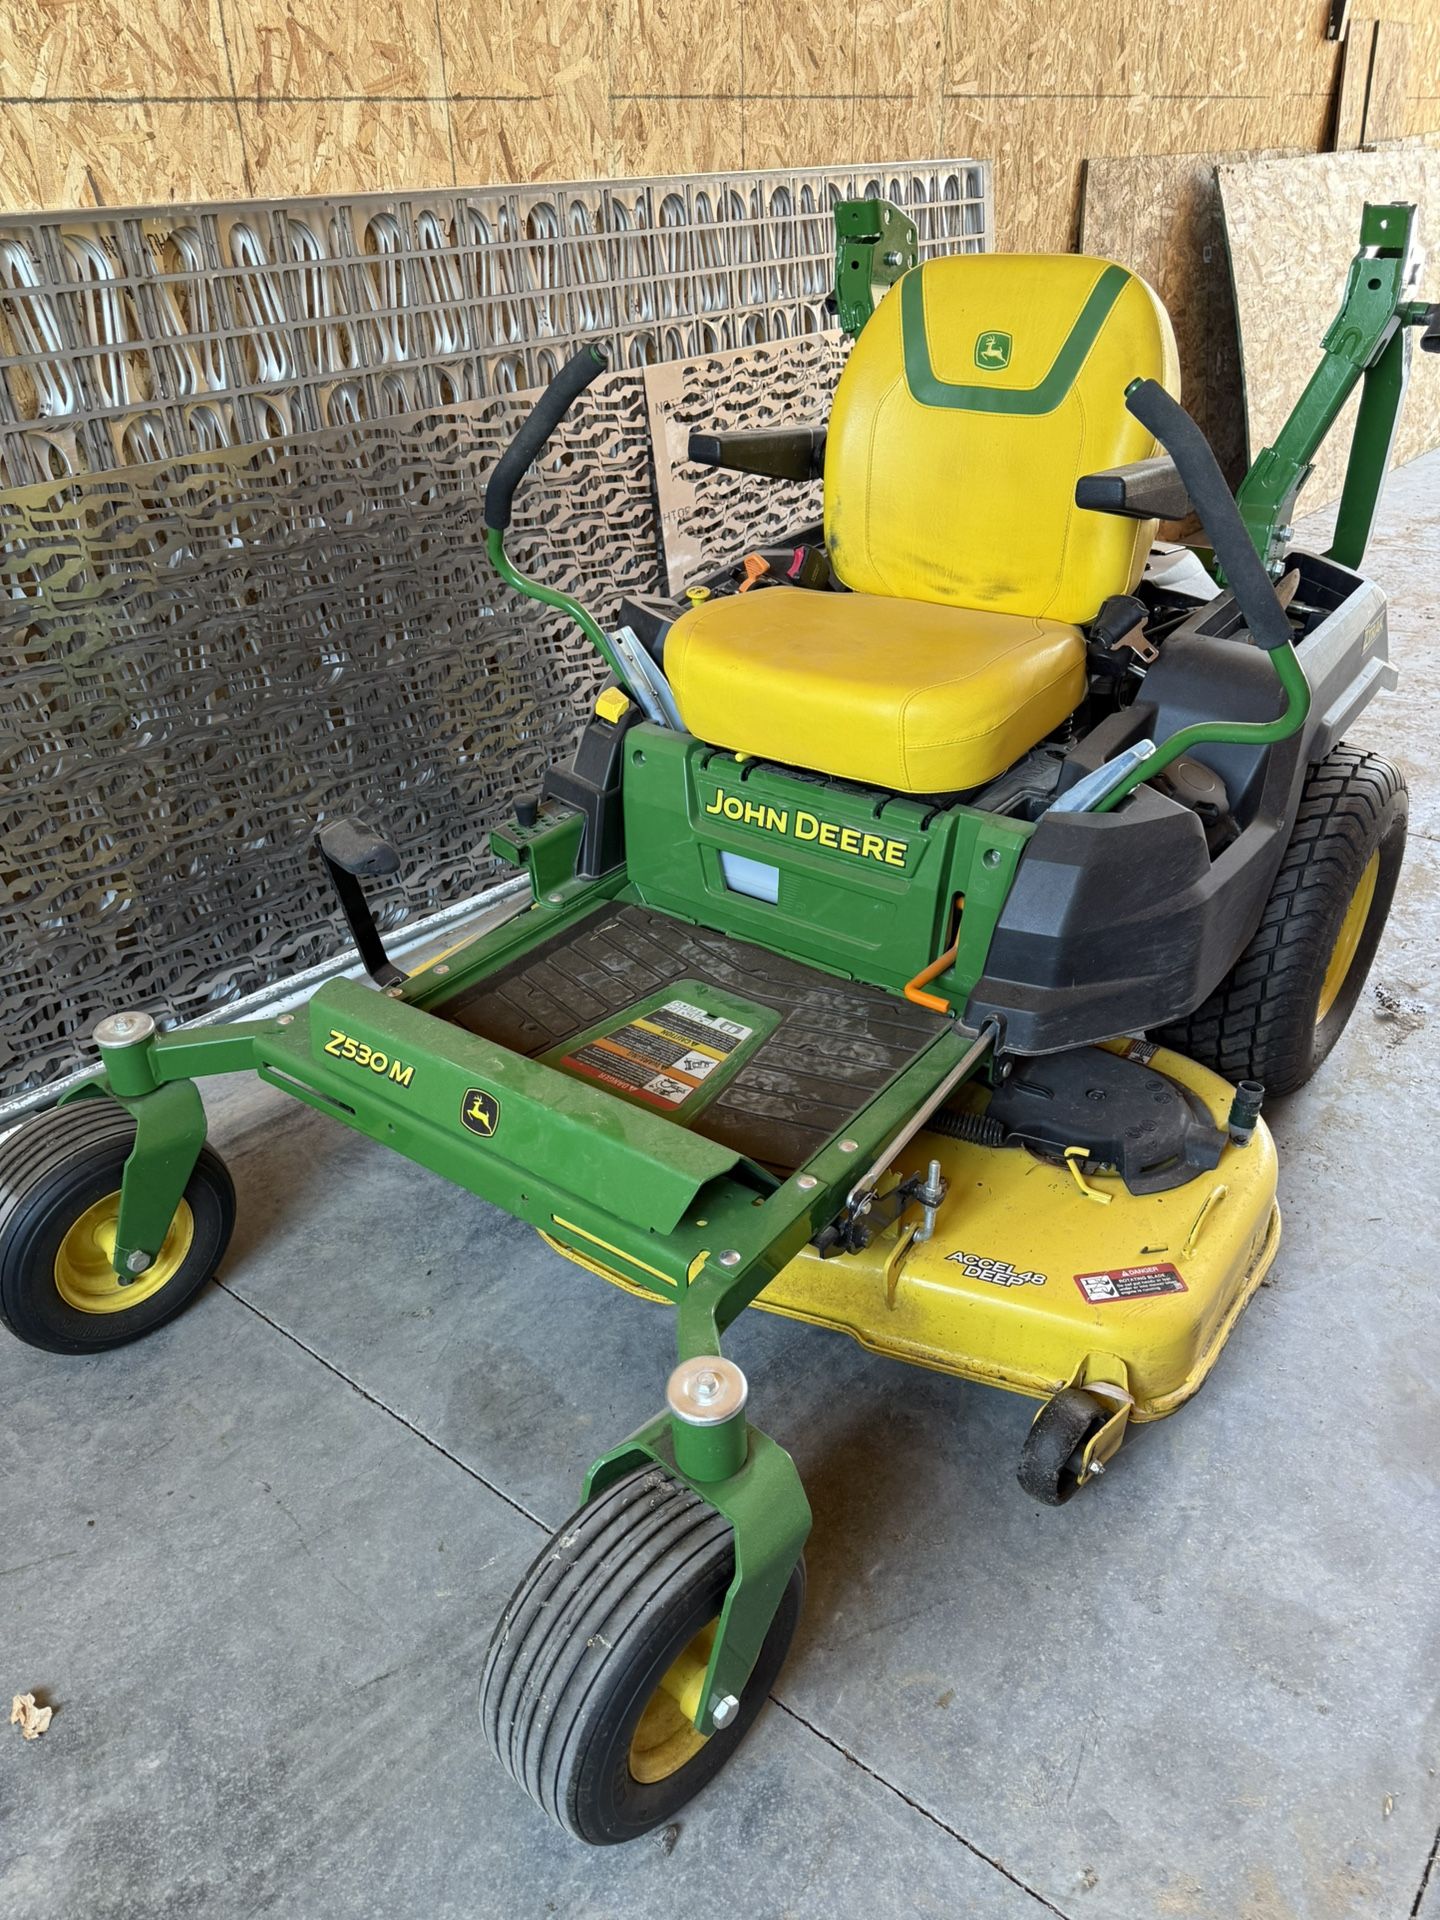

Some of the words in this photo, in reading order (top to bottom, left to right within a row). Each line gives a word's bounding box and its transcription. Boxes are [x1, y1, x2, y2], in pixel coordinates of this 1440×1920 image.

[706, 788, 788, 834] JOHN
[794, 811, 908, 868] DEERE
[661, 1029, 691, 1046] CAUTION
[597, 1072, 631, 1091] DANGER
[945, 1251, 1019, 1276] ACCEL
[1017, 1271, 1048, 1285] 48
[962, 1264, 1024, 1287] DEEP
[1128, 1266, 1159, 1276] DANGER
